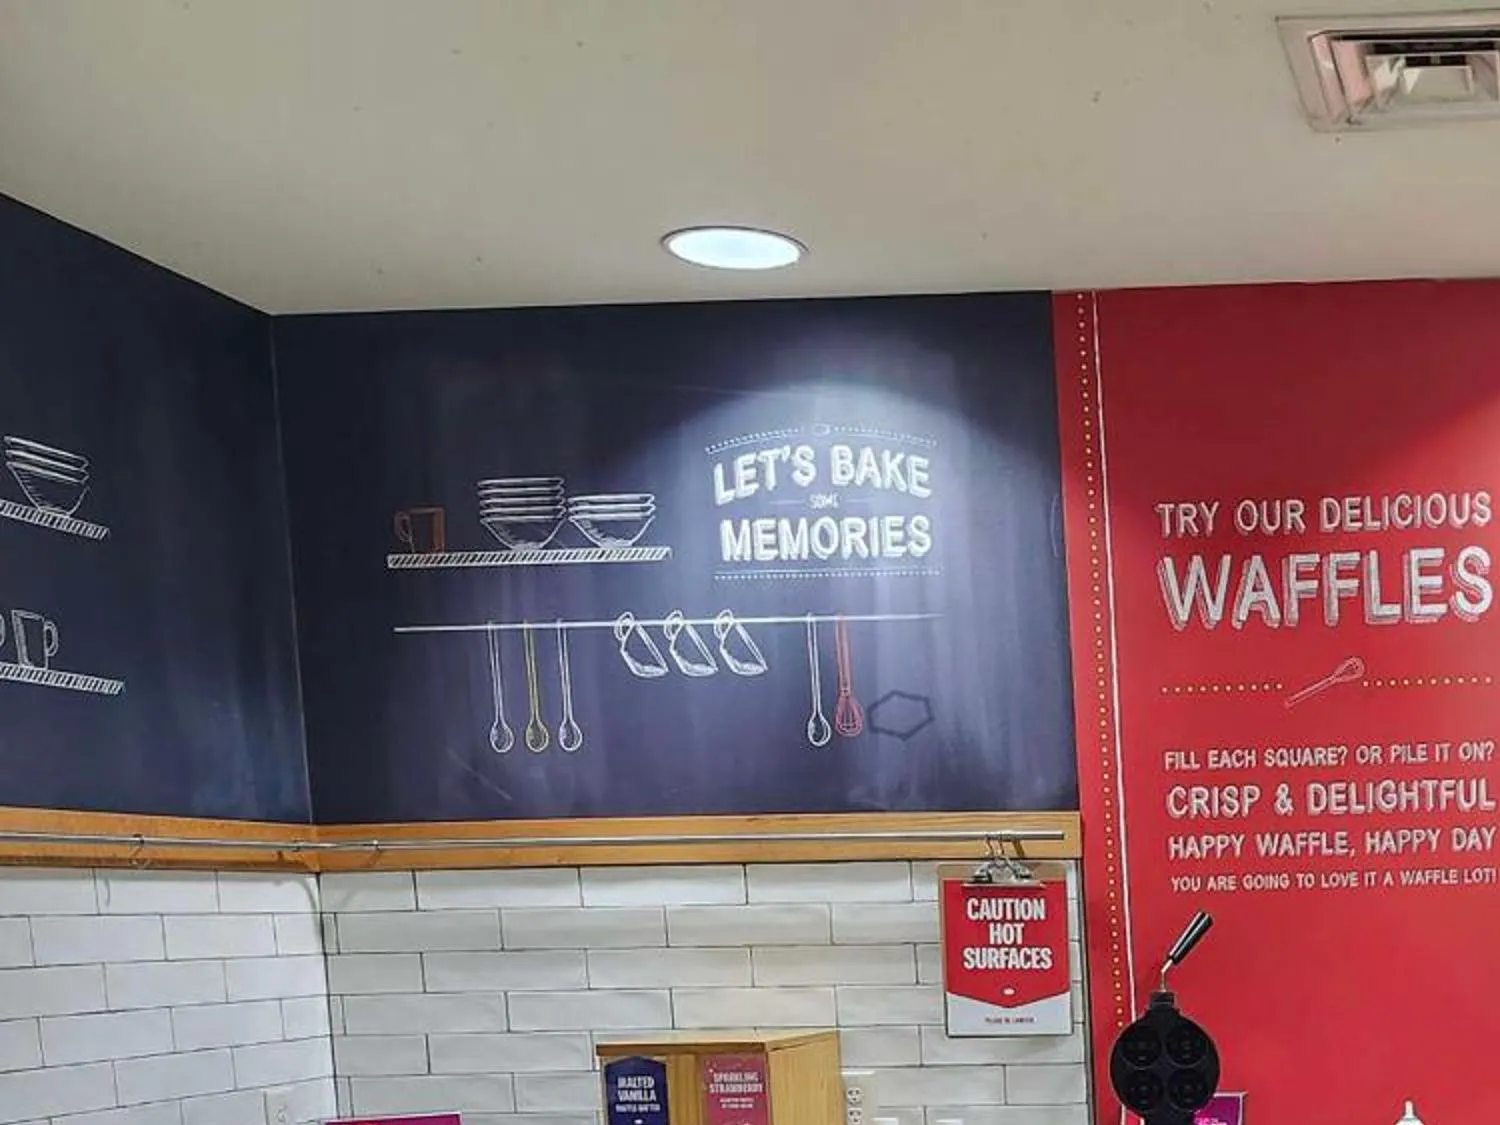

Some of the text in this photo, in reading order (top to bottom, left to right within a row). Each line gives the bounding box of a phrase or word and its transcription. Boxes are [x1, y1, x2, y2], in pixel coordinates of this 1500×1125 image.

[714, 444, 932, 505] LET'S BAKE
[1155, 492, 1493, 536] TRY OUR DELICIOUS
[720, 515, 932, 562] MEMORIES
[1157, 546, 1494, 630] WAFFLES
[1164, 740, 1496, 771] FILL EACH SQUARE? OR PILE IT ON?
[1166, 778, 1496, 819] CRISP & DELIGHTFUL
[1168, 826, 1496, 860] HAPPY WAFFLE, HAPPY DAY
[1171, 867, 1497, 892] YOU ARE GOING TO LOVE IT A WAFFLE LOT!
[967, 898, 1046, 920] CAUTION
[989, 923, 1024, 945] HOT
[963, 947, 1053, 969] SURFACES
[617, 1089, 657, 1102] VANILLA
